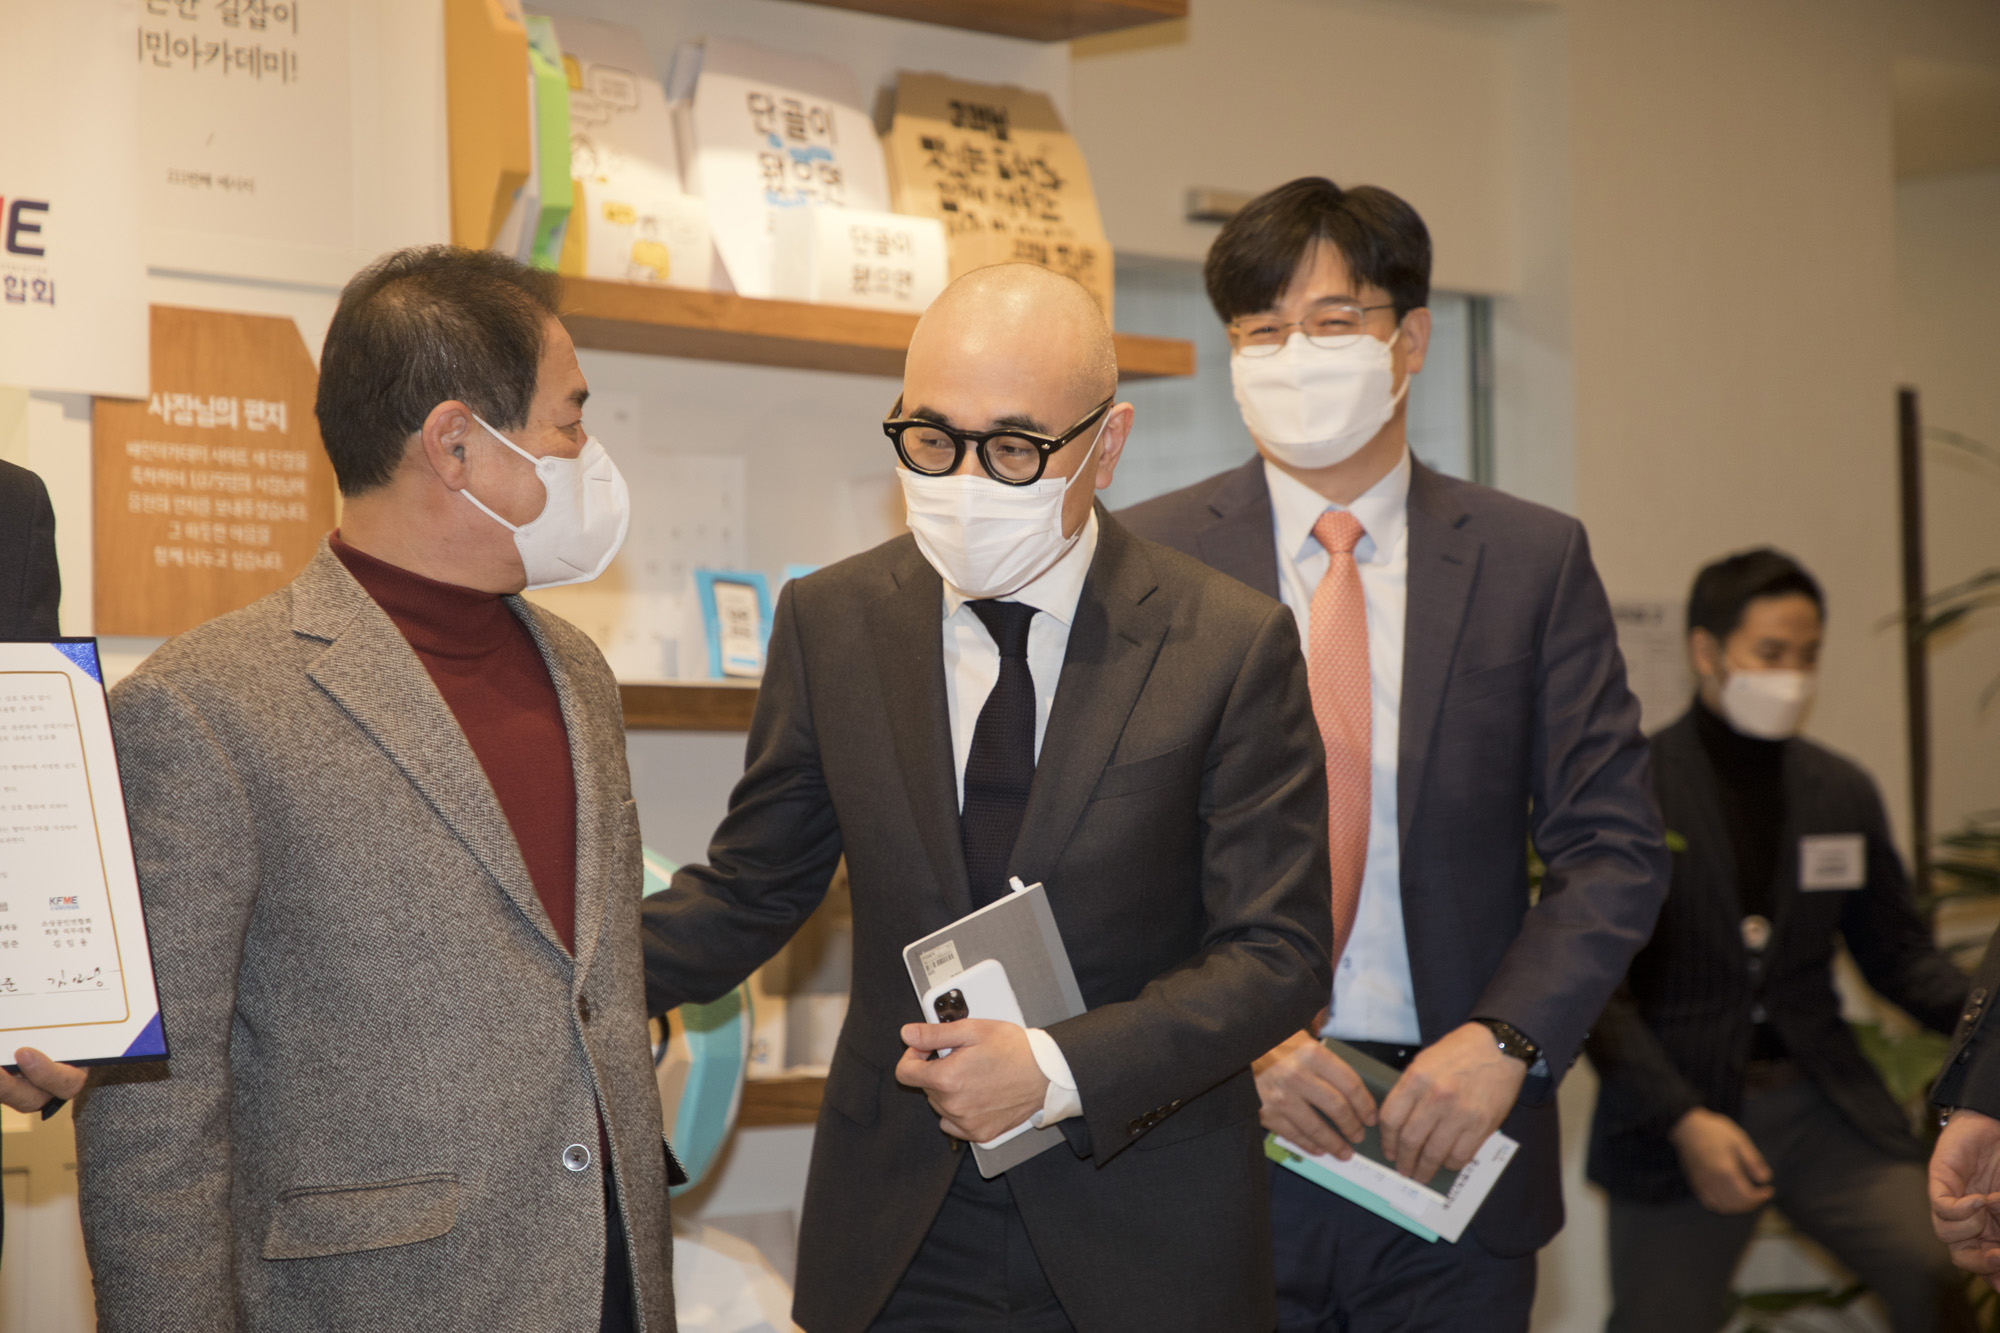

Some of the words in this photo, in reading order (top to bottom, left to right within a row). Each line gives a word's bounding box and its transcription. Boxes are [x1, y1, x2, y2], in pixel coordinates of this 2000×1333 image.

[748, 92, 838, 145] 단골이
[147, 391, 238, 430] 사장님의
[49, 895, 78, 905] KFME
